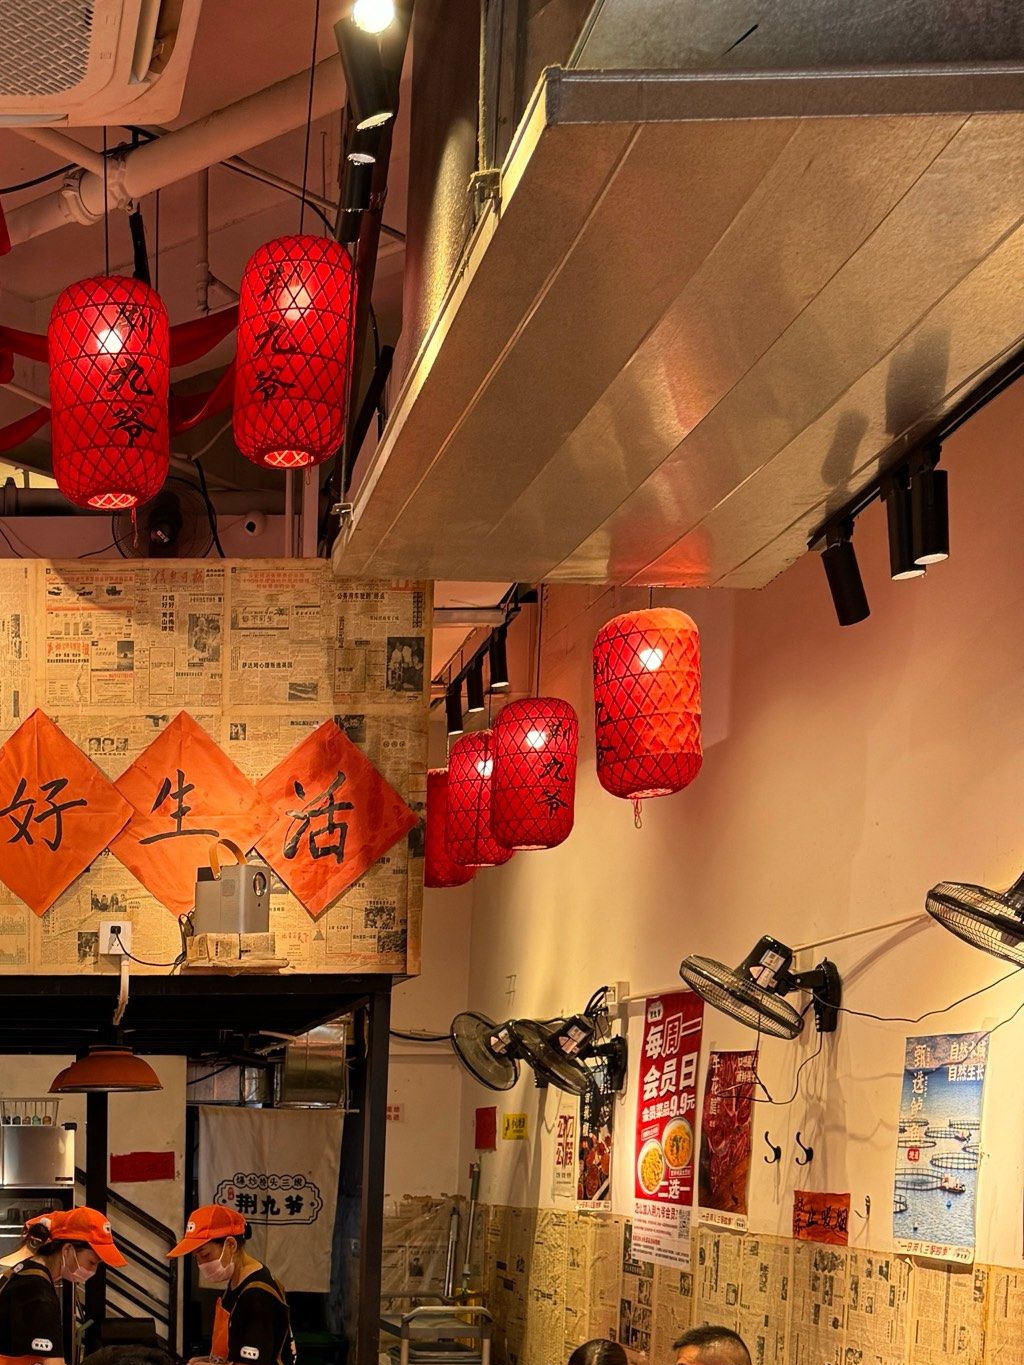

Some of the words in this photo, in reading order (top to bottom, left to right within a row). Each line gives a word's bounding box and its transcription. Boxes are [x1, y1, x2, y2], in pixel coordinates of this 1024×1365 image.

[645, 1012, 703, 1060] 每周一
[643, 1052, 699, 1101] 会员日
[948, 1063, 985, 1082] 自然生长
[657, 1180, 690, 1200] 二选一
[235, 1192, 304, 1216] 荆九爷
